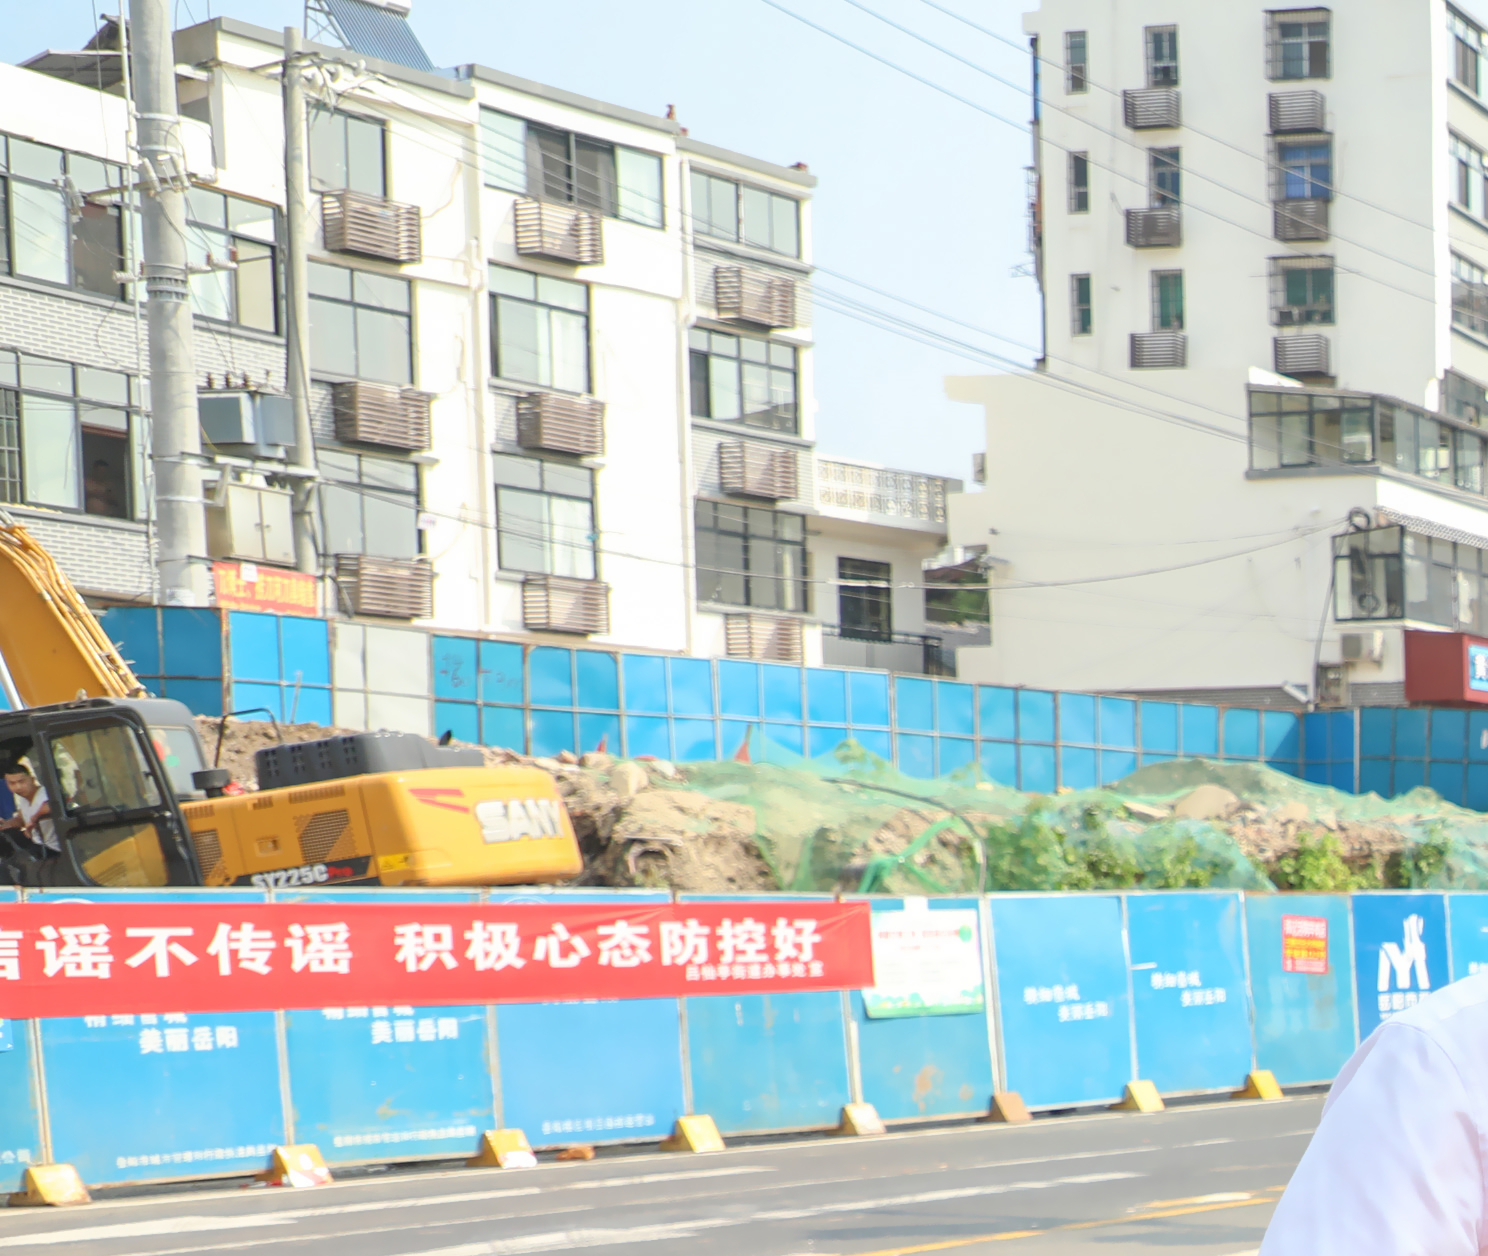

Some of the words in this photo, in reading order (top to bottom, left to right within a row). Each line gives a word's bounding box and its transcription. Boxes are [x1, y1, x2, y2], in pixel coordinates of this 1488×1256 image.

[394, 917, 822, 973] 积极心态防控好
[139, 1025, 239, 1055] 美丽岳阳
